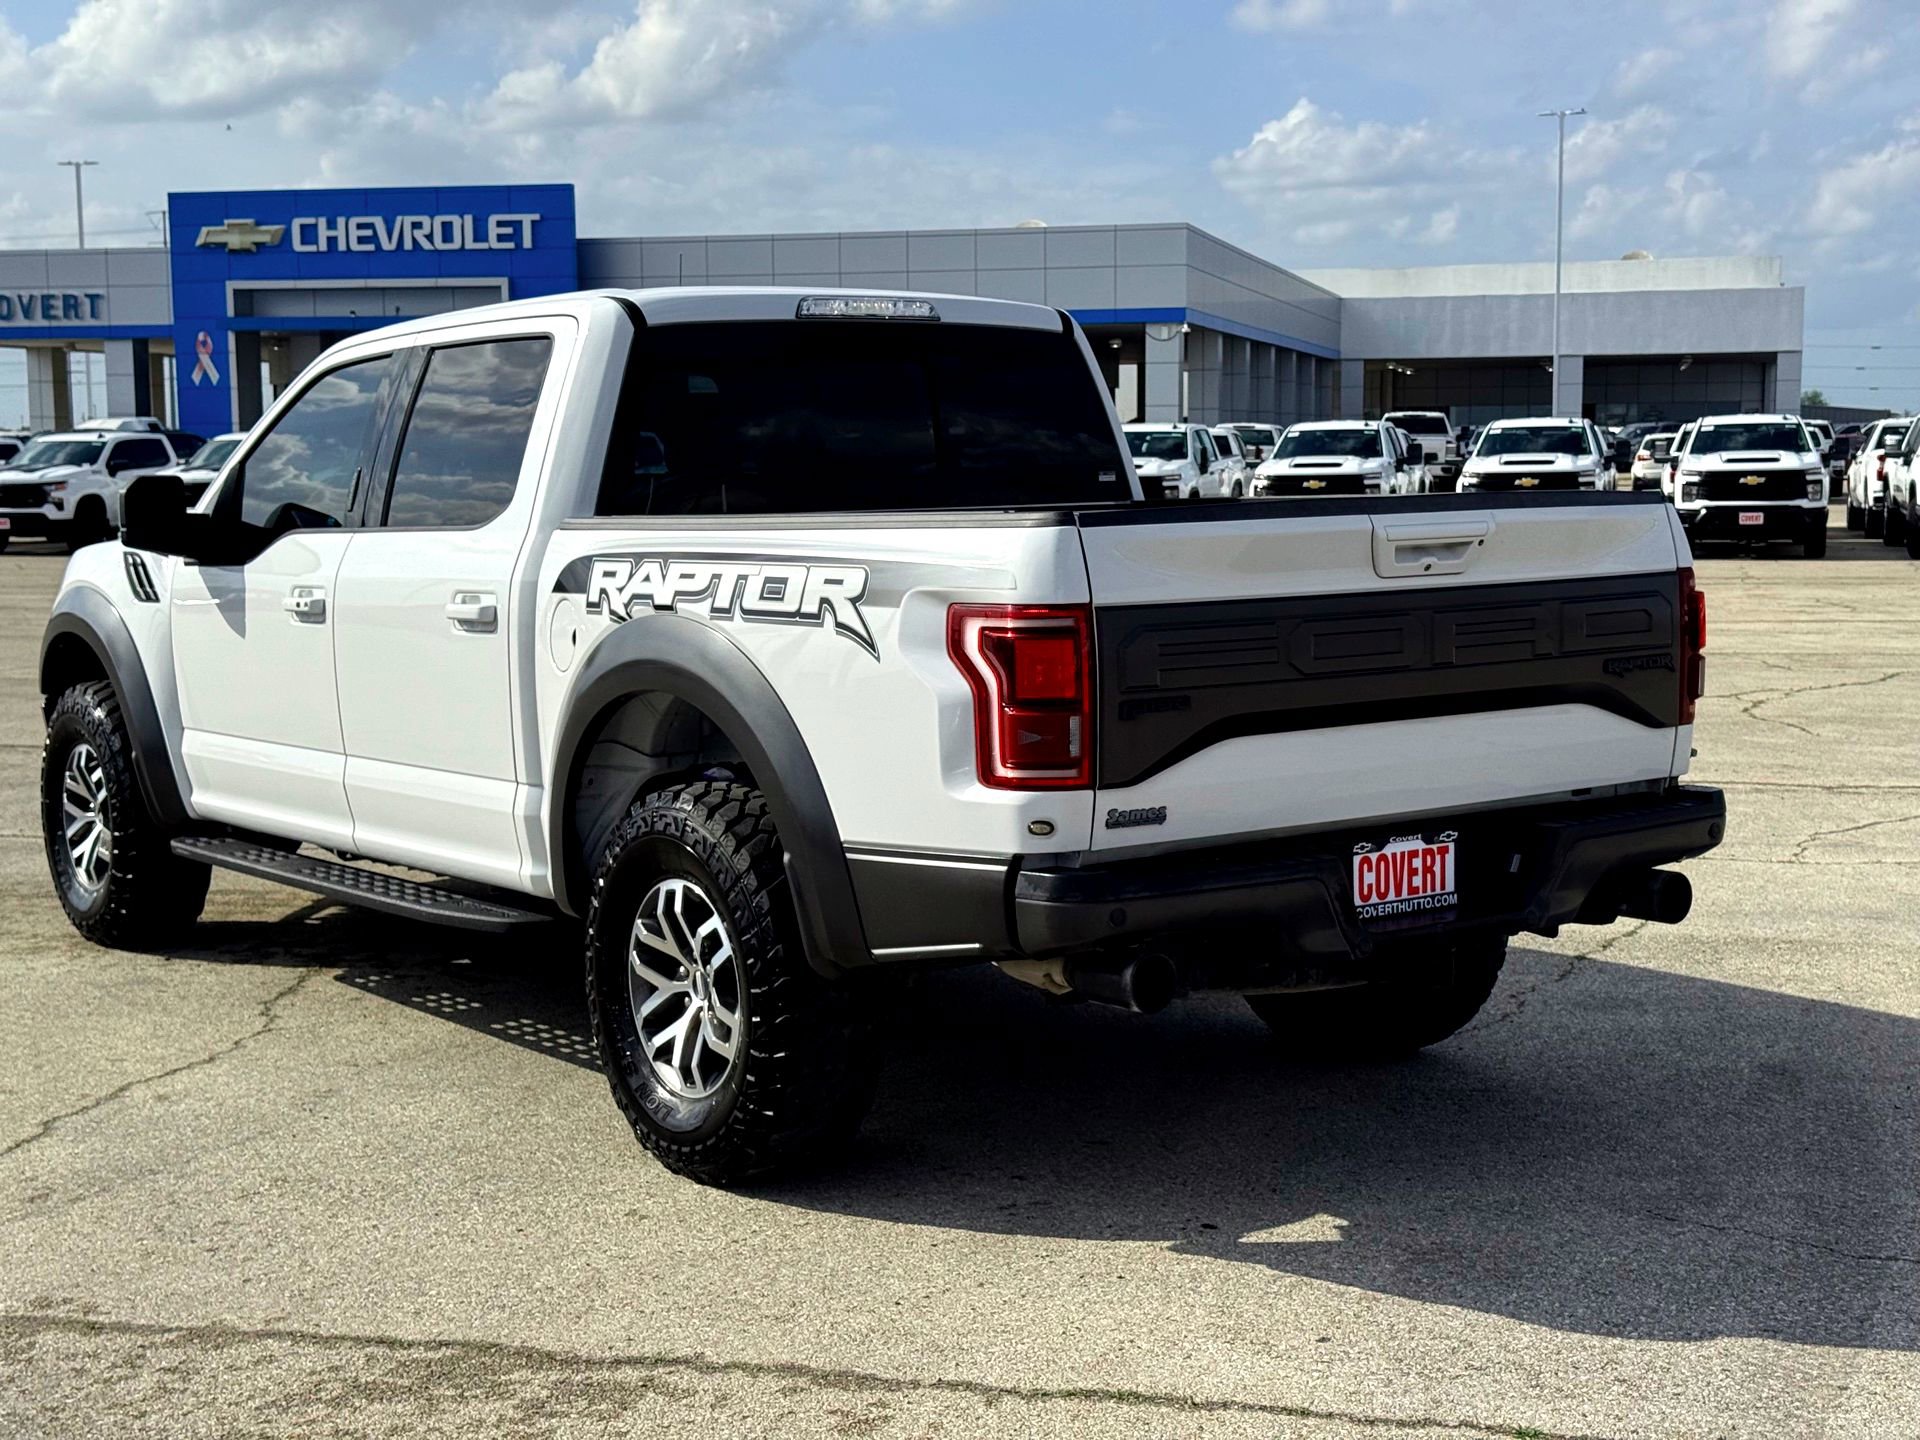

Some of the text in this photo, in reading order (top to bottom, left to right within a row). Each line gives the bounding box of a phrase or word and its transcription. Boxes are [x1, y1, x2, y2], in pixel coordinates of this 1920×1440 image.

[291, 213, 541, 252] CHEVROLET
[586, 557, 880, 663] RAPTOR
[1118, 591, 1673, 692] FORD
[1390, 834, 1421, 844] Covert
[1358, 845, 1449, 904] COVERT
[1356, 894, 1457, 919] COVERTHUTTO.COM
